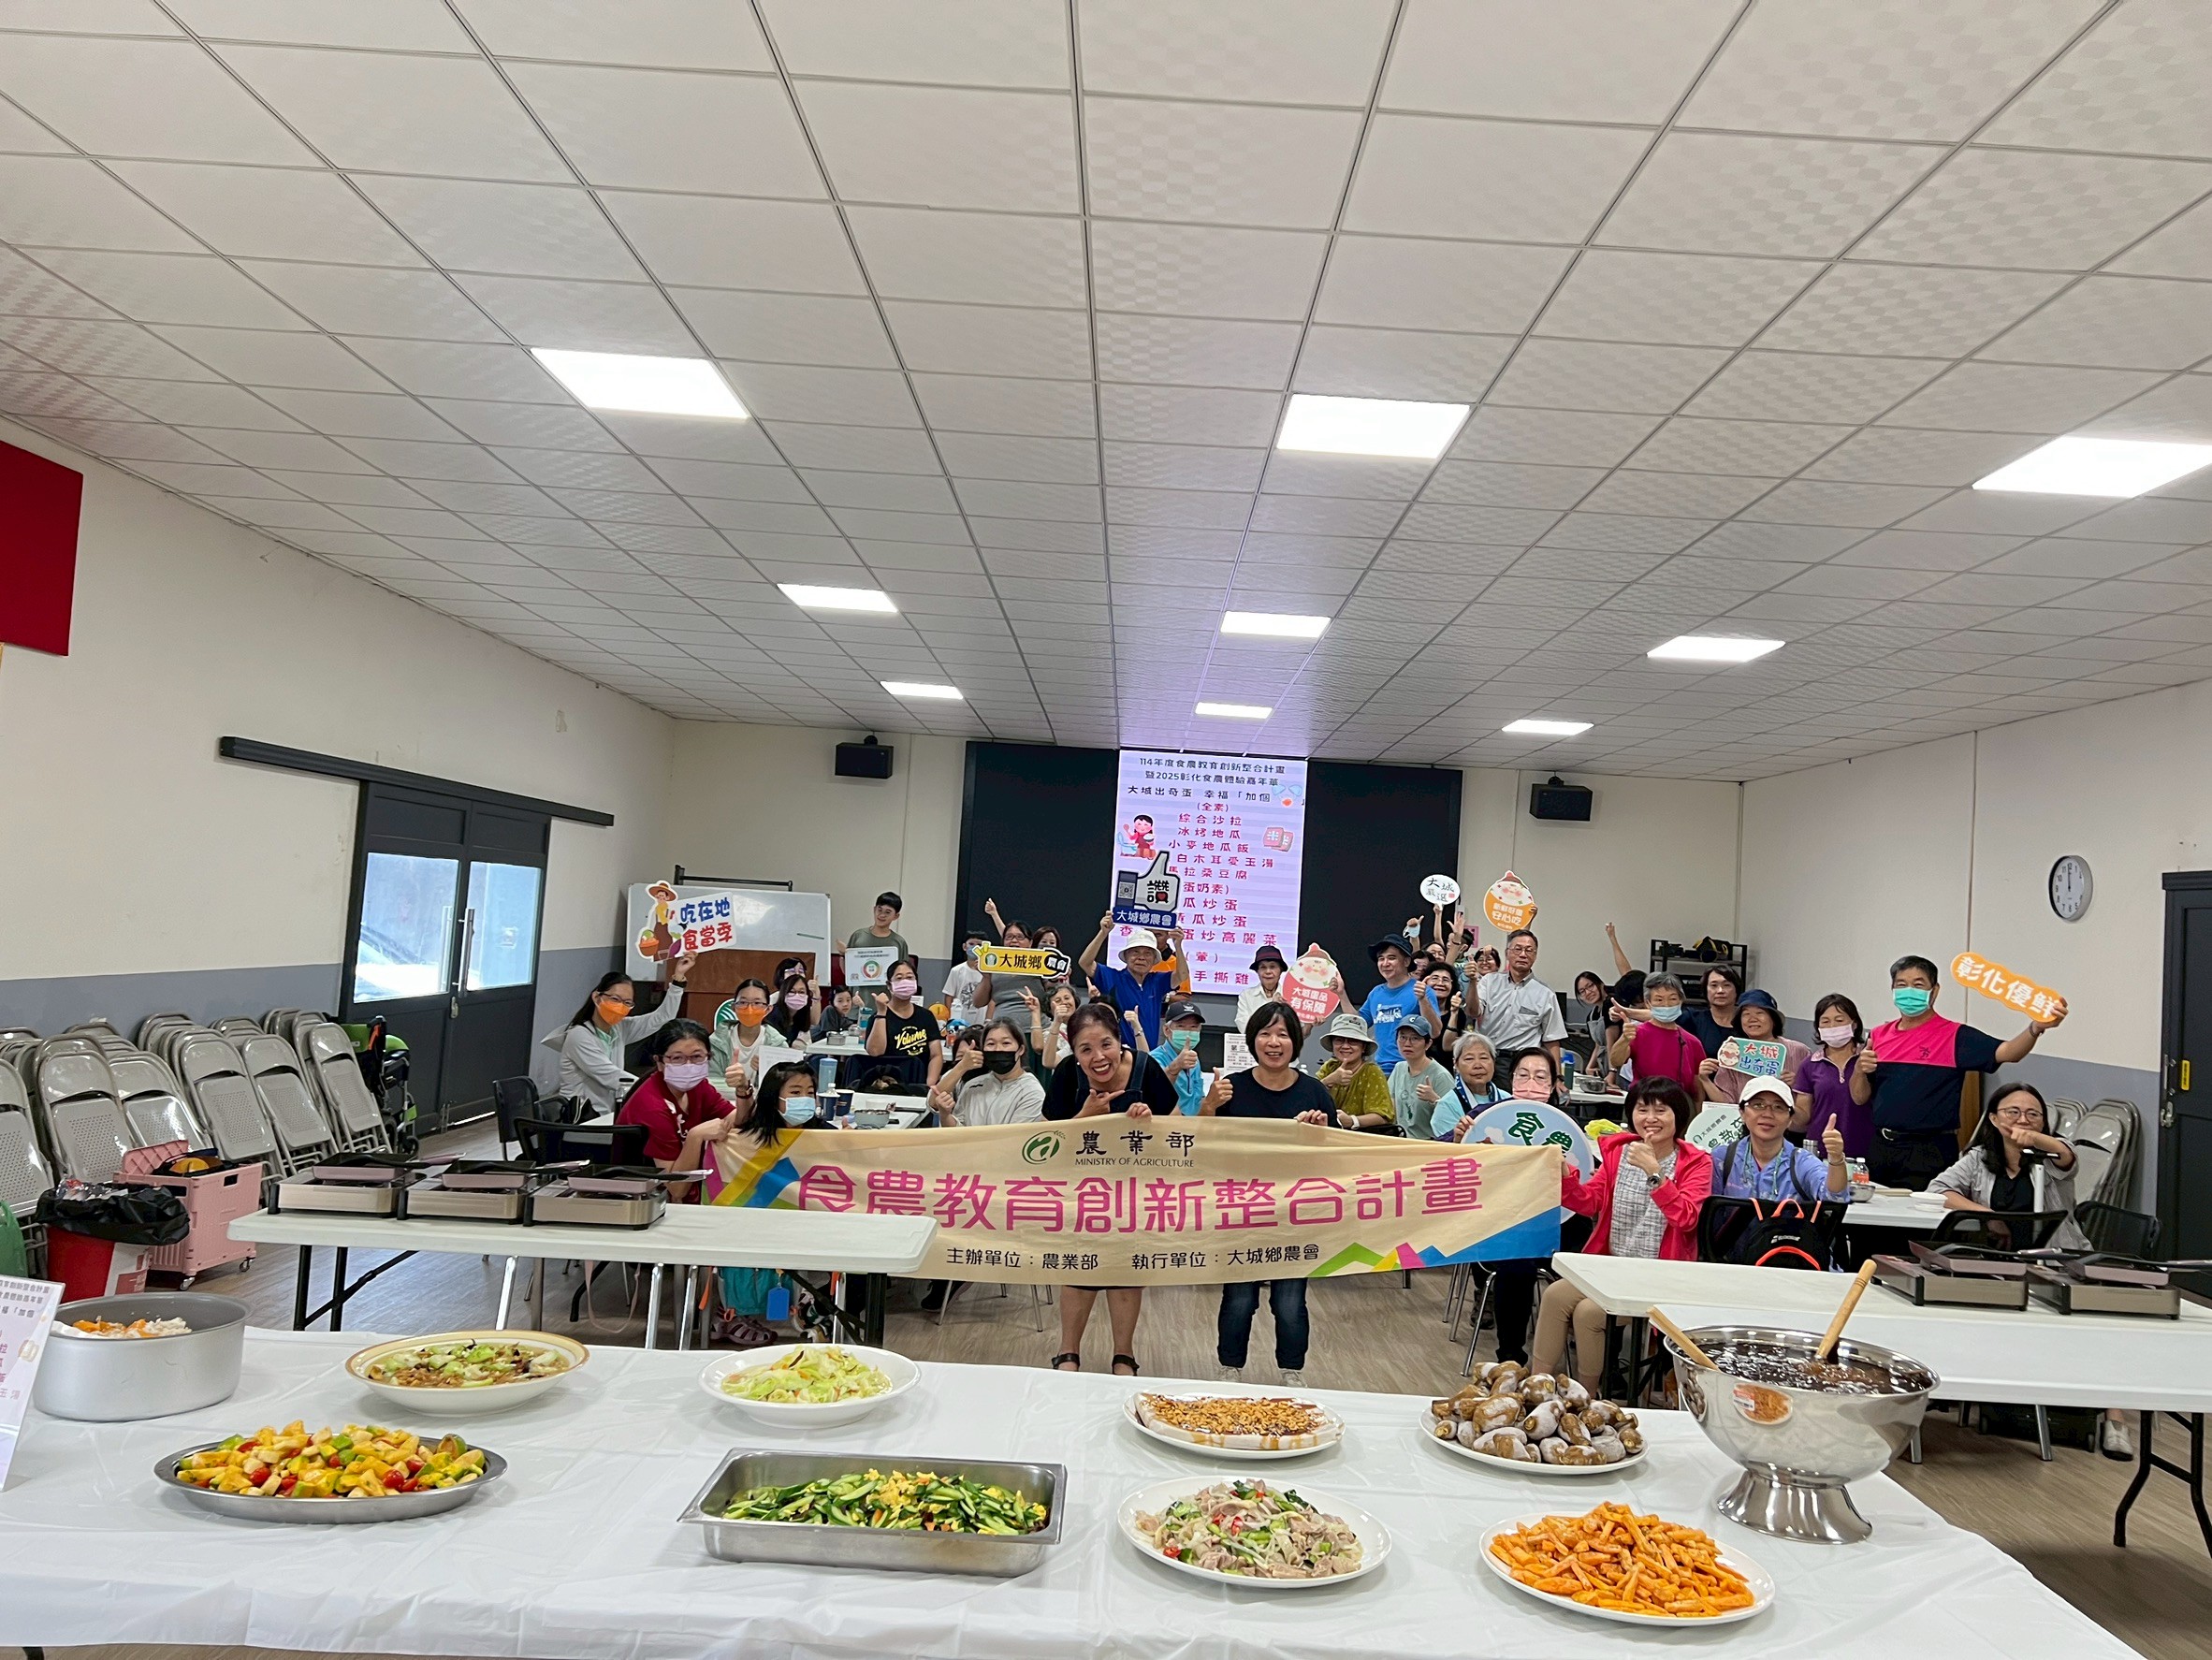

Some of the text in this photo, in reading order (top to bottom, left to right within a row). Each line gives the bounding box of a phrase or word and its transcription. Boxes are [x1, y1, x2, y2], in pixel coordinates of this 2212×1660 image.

[1128, 786, 1192, 798] 大城出奇蛋
[1178, 813, 1242, 826] 綜合沙拉
[1177, 826, 1241, 839] 冰烤地瓜
[1168, 840, 1249, 853] 小麥地瓜飯
[1183, 881, 1230, 896] 蛋奶素)
[680, 896, 731, 924] 吃在地
[1183, 896, 1238, 911] 瓜炒蛋
[1116, 910, 1172, 926] 大城鄉農會
[682, 922, 733, 951] 食當季
[998, 954, 1043, 970] 大城鄉
[1955, 955, 2059, 1019] 彰化優鮮
[1290, 996, 1327, 1014] 有保障
[1743, 1042, 1780, 1059] 大城
[1739, 1056, 1780, 1077] 出奇蛋
[1075, 1129, 1196, 1158] 農業部
[1075, 1157, 1195, 1168] MINISTRY OF AGRICULTURE
[797, 1157, 1484, 1234] 食農教育創新整合計畫
